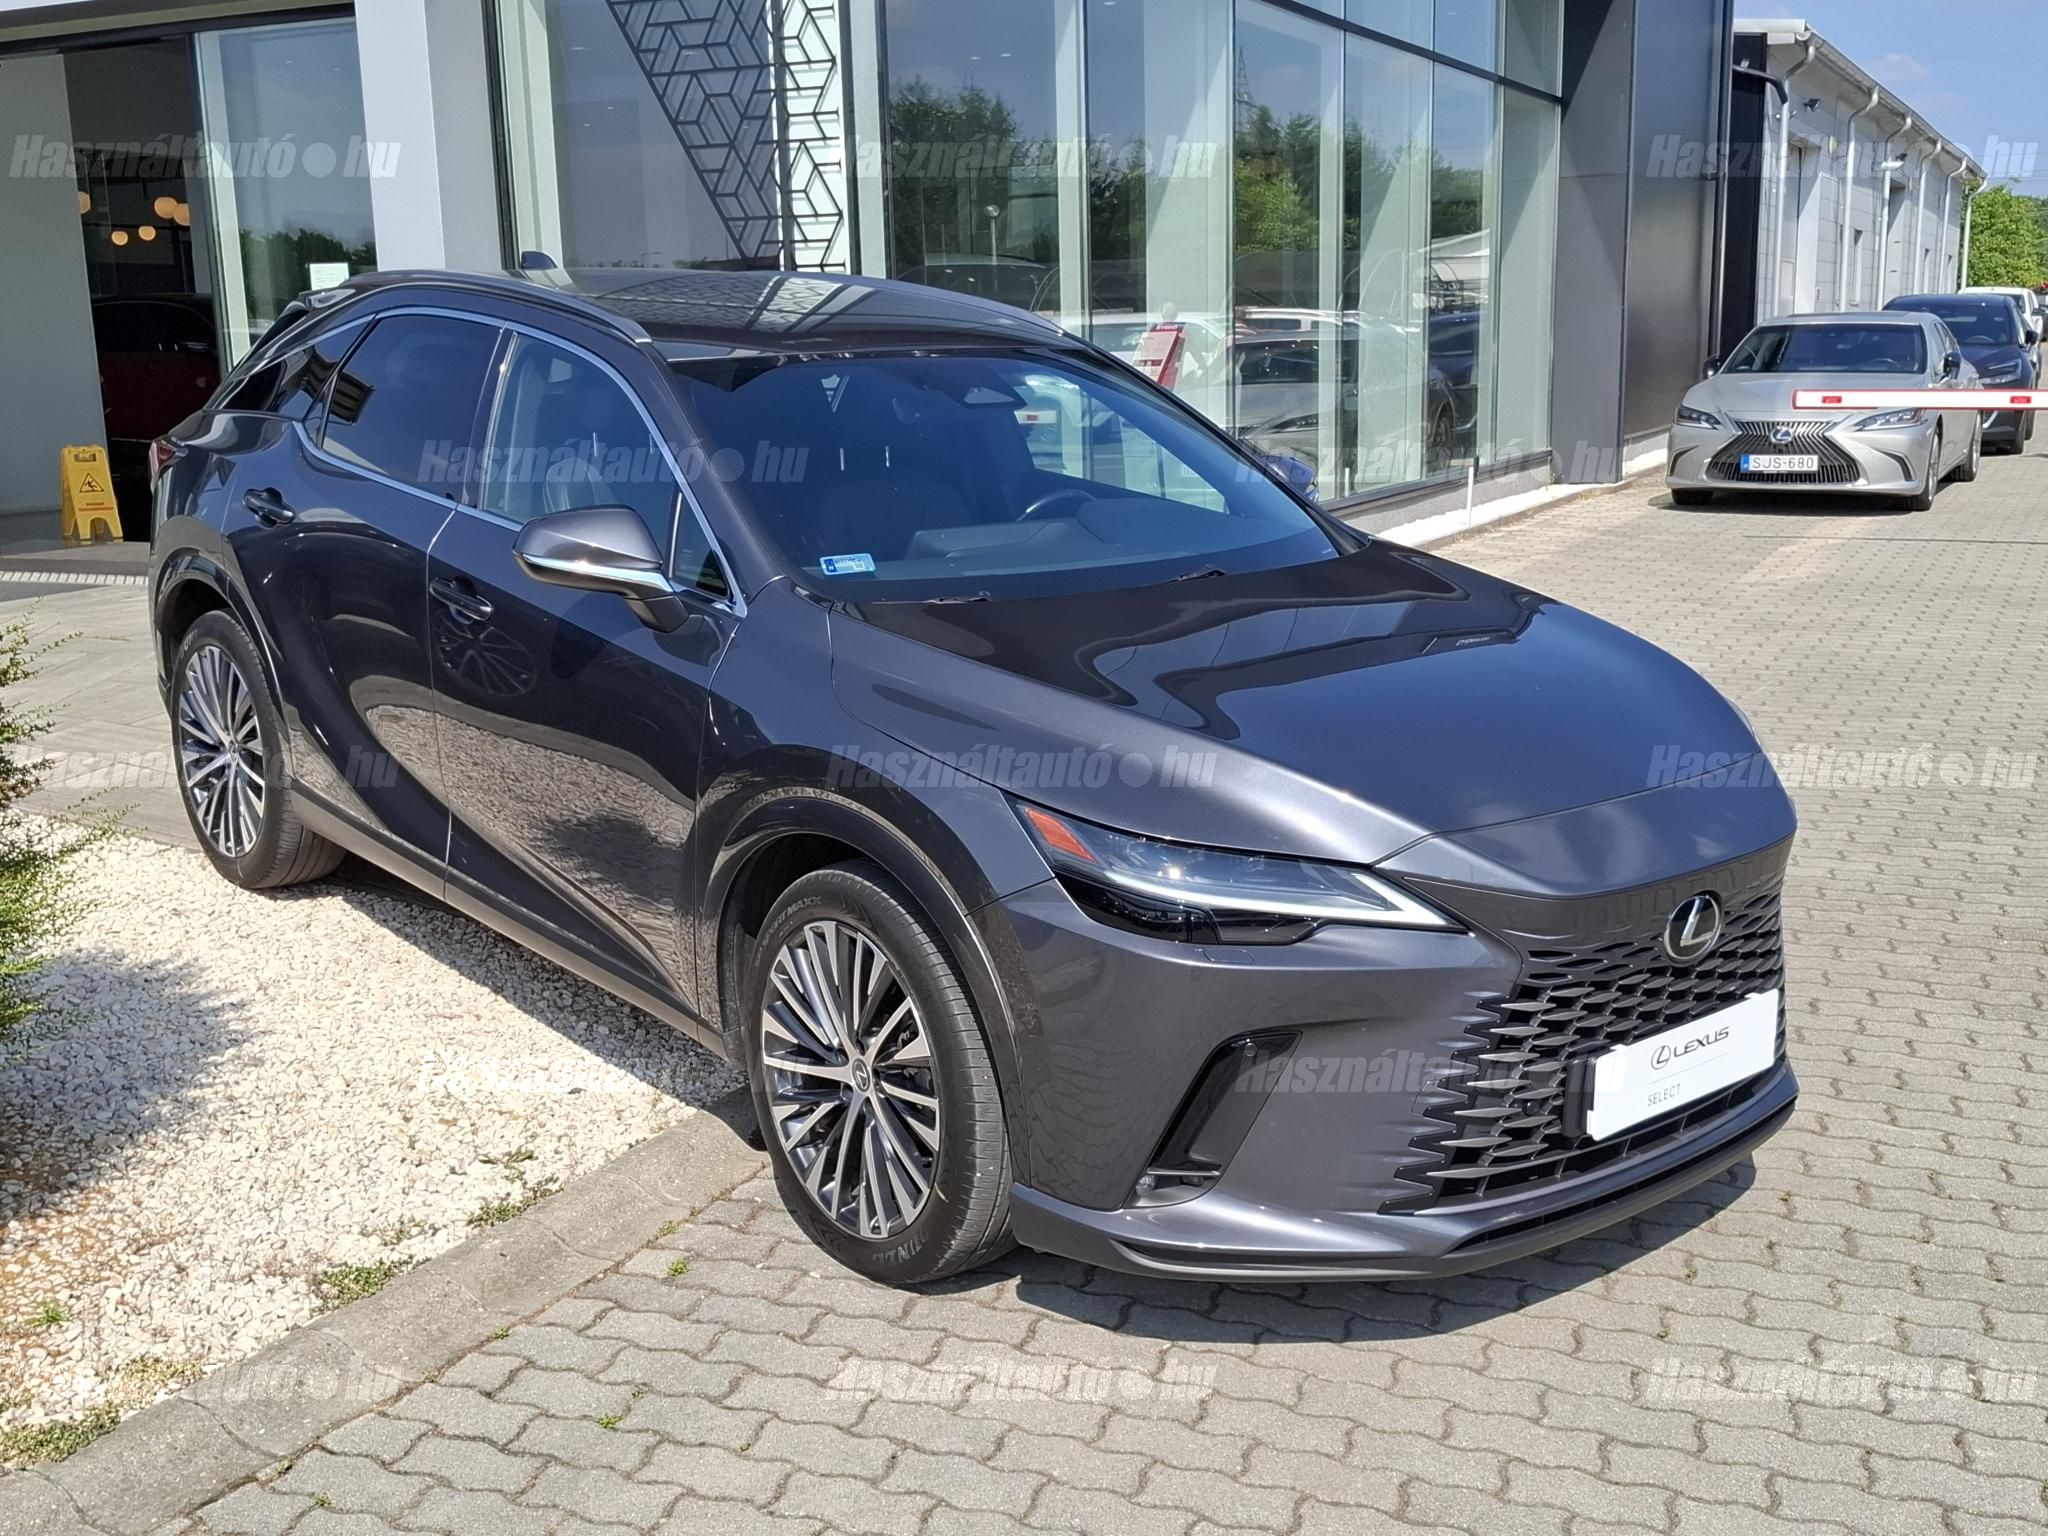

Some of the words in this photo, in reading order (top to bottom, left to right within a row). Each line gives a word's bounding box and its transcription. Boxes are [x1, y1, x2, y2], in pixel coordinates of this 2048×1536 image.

[1752, 457, 1814, 469] SJS-680
[1673, 1026, 1729, 1058] LEXUS
[1648, 1083, 1681, 1107] SELECT
